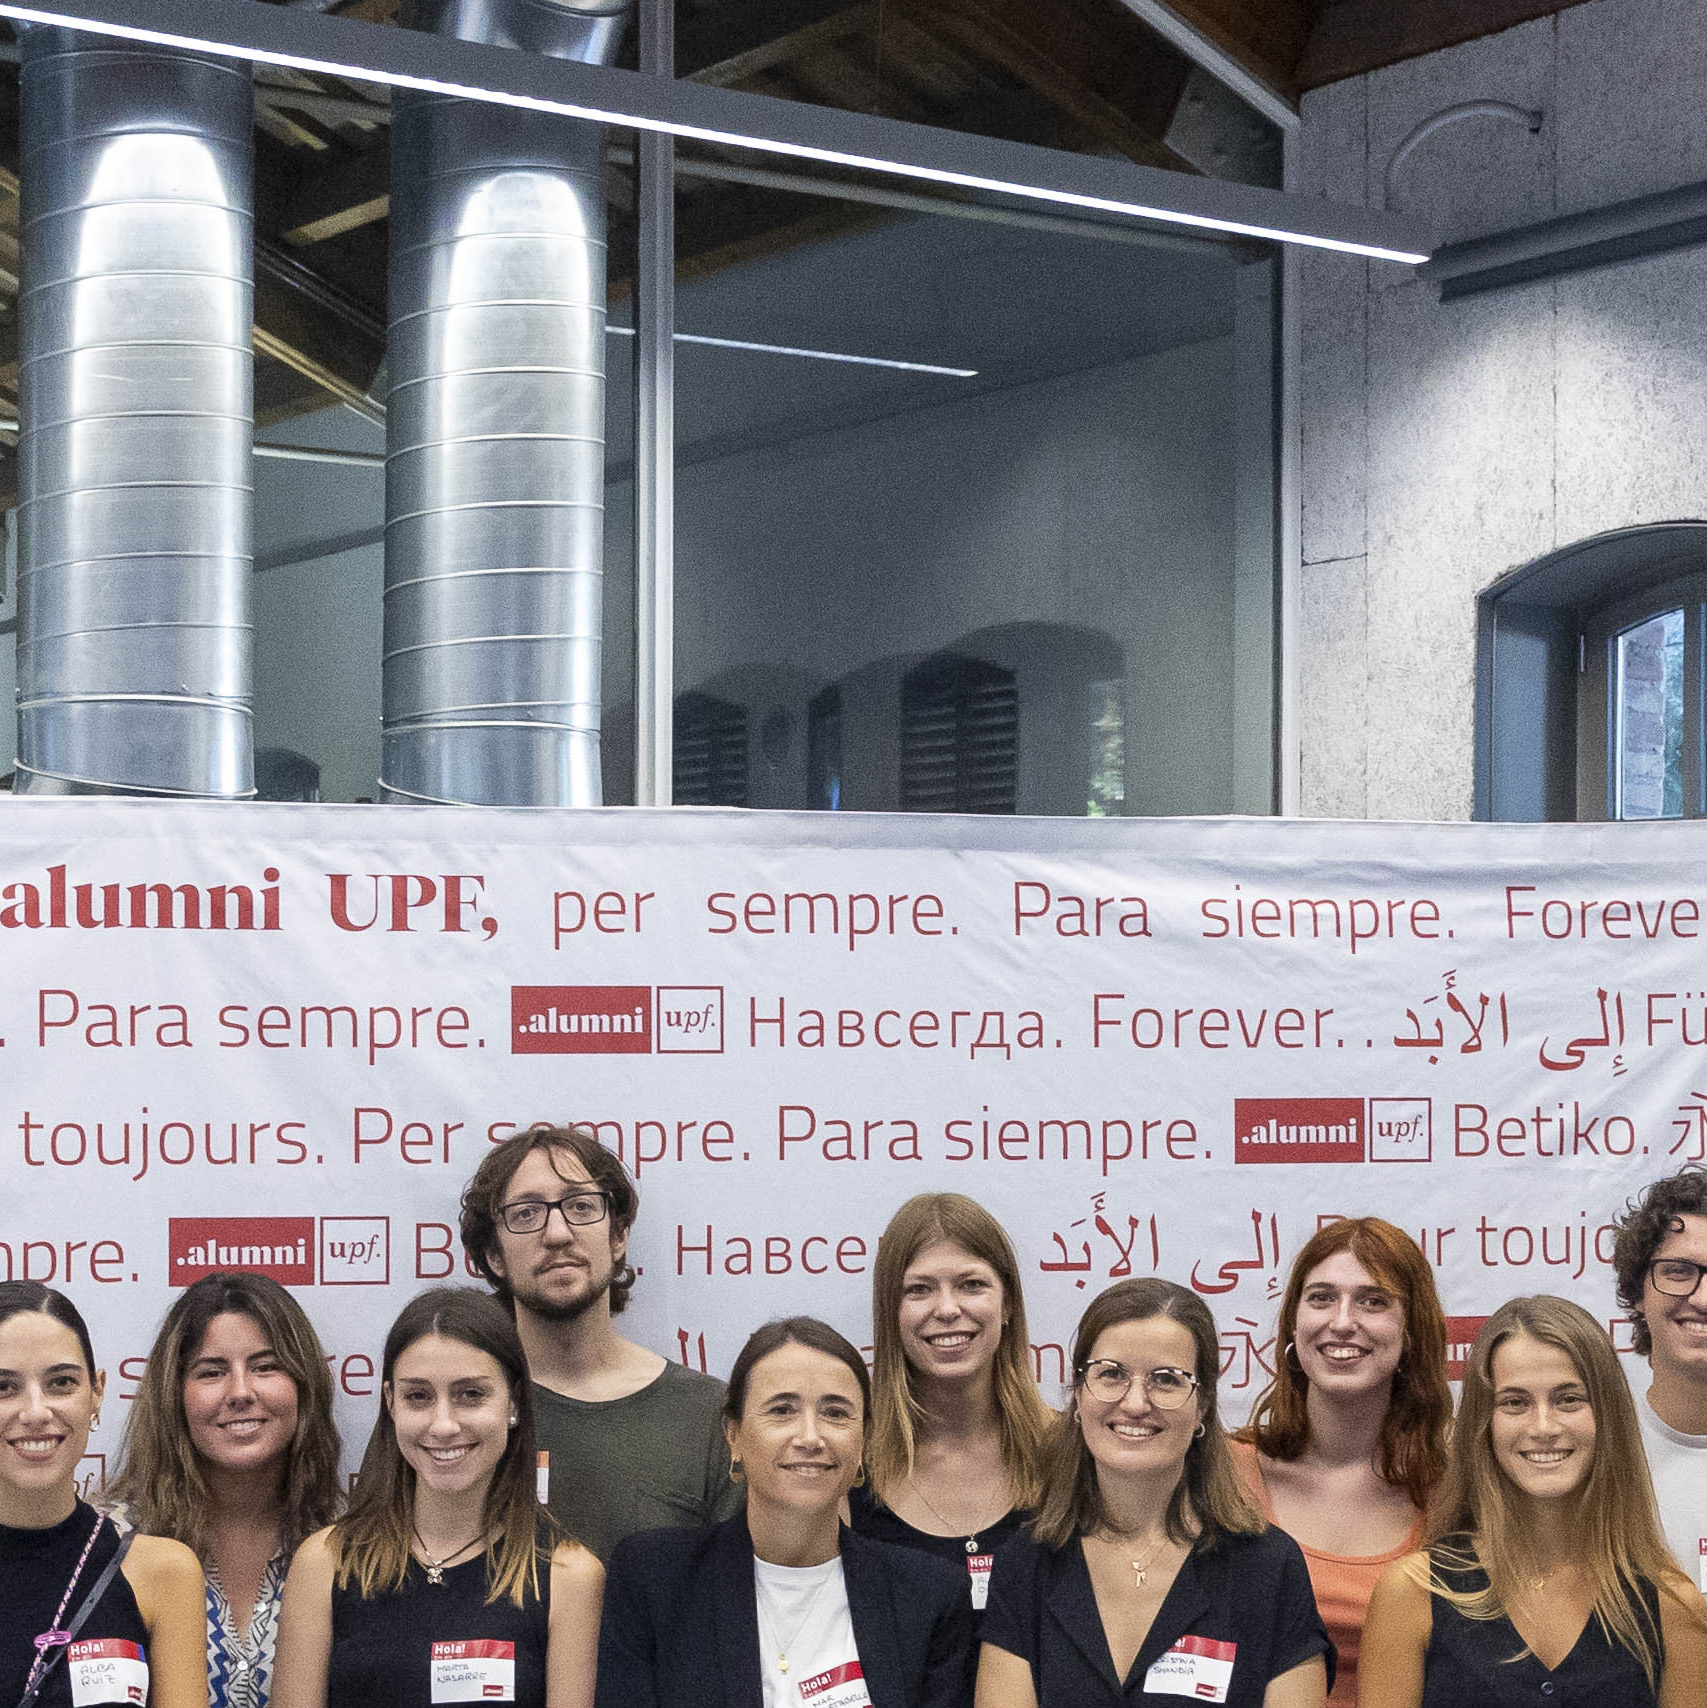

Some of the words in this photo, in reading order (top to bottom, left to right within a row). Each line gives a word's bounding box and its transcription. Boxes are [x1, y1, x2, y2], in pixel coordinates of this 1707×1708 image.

[0, 864, 283, 932] alumni
[328, 873, 499, 941] UPF,
[554, 888, 655, 949] per
[706, 888, 959, 953] sempre.
[1013, 881, 1152, 937] Para
[1201, 886, 1455, 955] siempre.
[38, 988, 192, 1048] Para
[218, 1004, 487, 1066] sempre.
[518, 1006, 644, 1034] .alumni
[664, 1003, 716, 1034] upf.
[749, 996, 1063, 1059] Навсегда.
[1093, 993, 1344, 1049] Forever.
[18, 1107, 324, 1181] toujours.
[354, 1107, 464, 1164] Per
[487, 1120, 750, 1180] smpre.
[778, 1105, 923, 1161] Para
[944, 1104, 1213, 1177] siempre.
[1240, 1117, 1358, 1145] .alumni
[1377, 1113, 1425, 1141] upf.
[1454, 1101, 1649, 1158] Betiko.
[175, 1236, 308, 1267] .alumni
[328, 1231, 382, 1264] upf.
[676, 1224, 885, 1276] Навсе
[1476, 1210, 1615, 1280] toujo
[69, 1641, 105, 1657] Hola!
[434, 1643, 466, 1655] Hola!
[800, 1672, 833, 1694] Hola!
